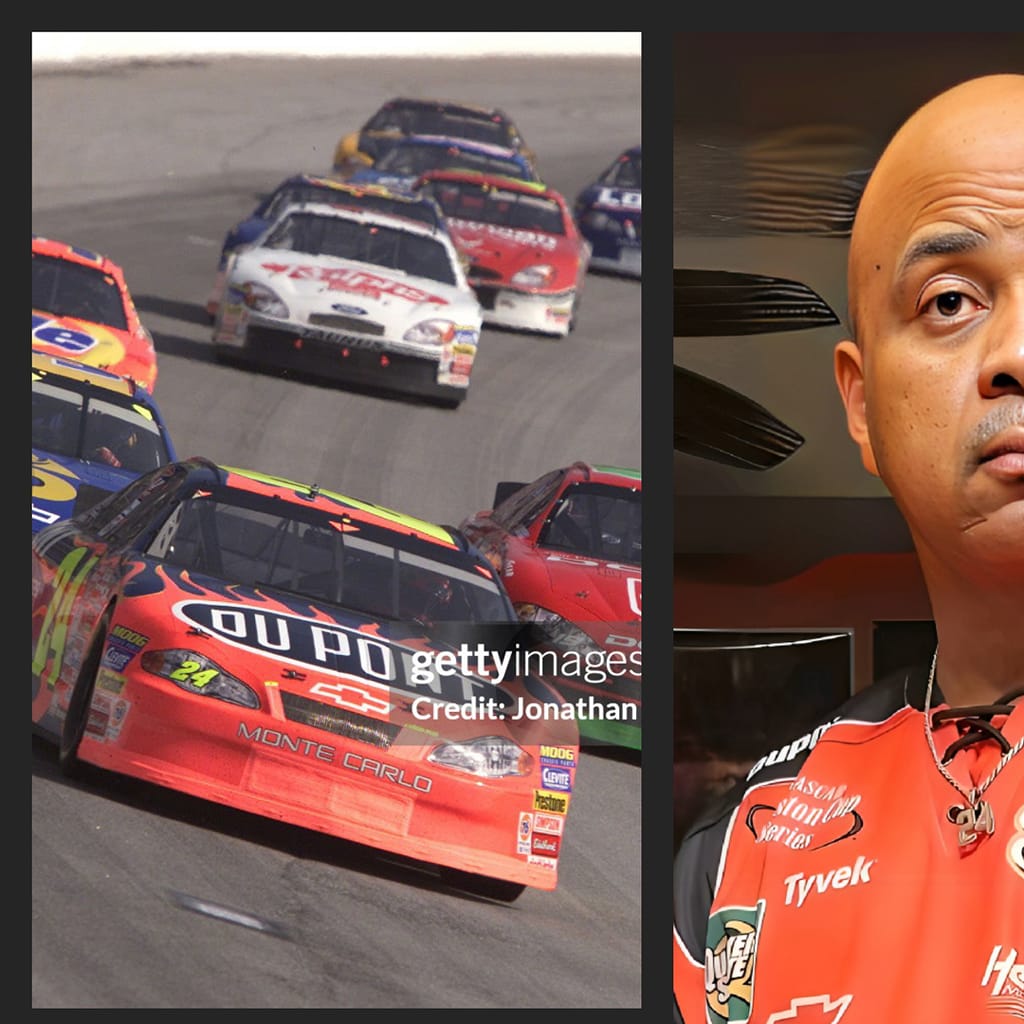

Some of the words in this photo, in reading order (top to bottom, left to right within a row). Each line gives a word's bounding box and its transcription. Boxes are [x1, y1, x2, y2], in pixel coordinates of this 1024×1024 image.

[170, 660, 219, 688] 24
[238, 722, 336, 763] MONTE
[342, 753, 433, 793] CARLO
[784, 856, 874, 907] Tyvek
